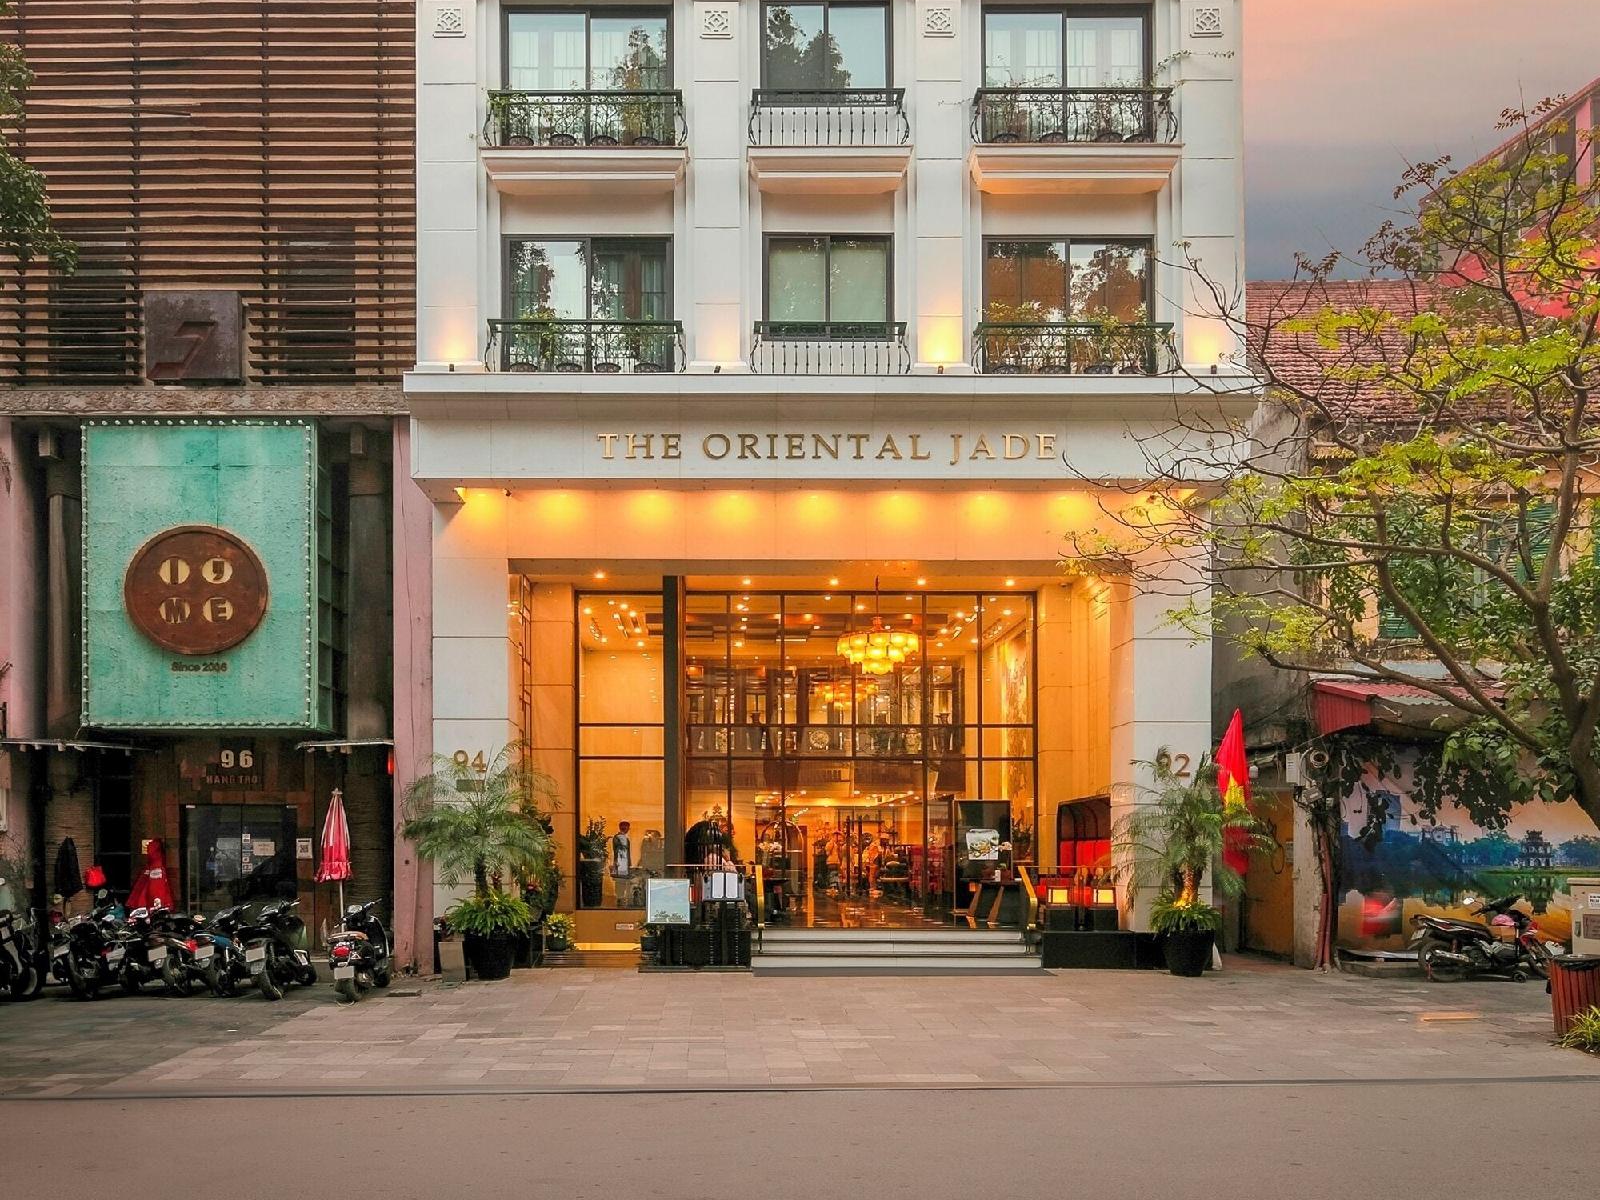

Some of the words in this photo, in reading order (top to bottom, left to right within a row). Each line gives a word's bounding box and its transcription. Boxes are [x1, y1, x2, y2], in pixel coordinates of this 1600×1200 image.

[597, 433, 682, 460] THE
[702, 433, 932, 461] ORIENTAL
[949, 433, 1058, 466] JADE
[171, 661, 201, 672] Since
[220, 749, 254, 769] 96
[453, 749, 487, 773] 94
